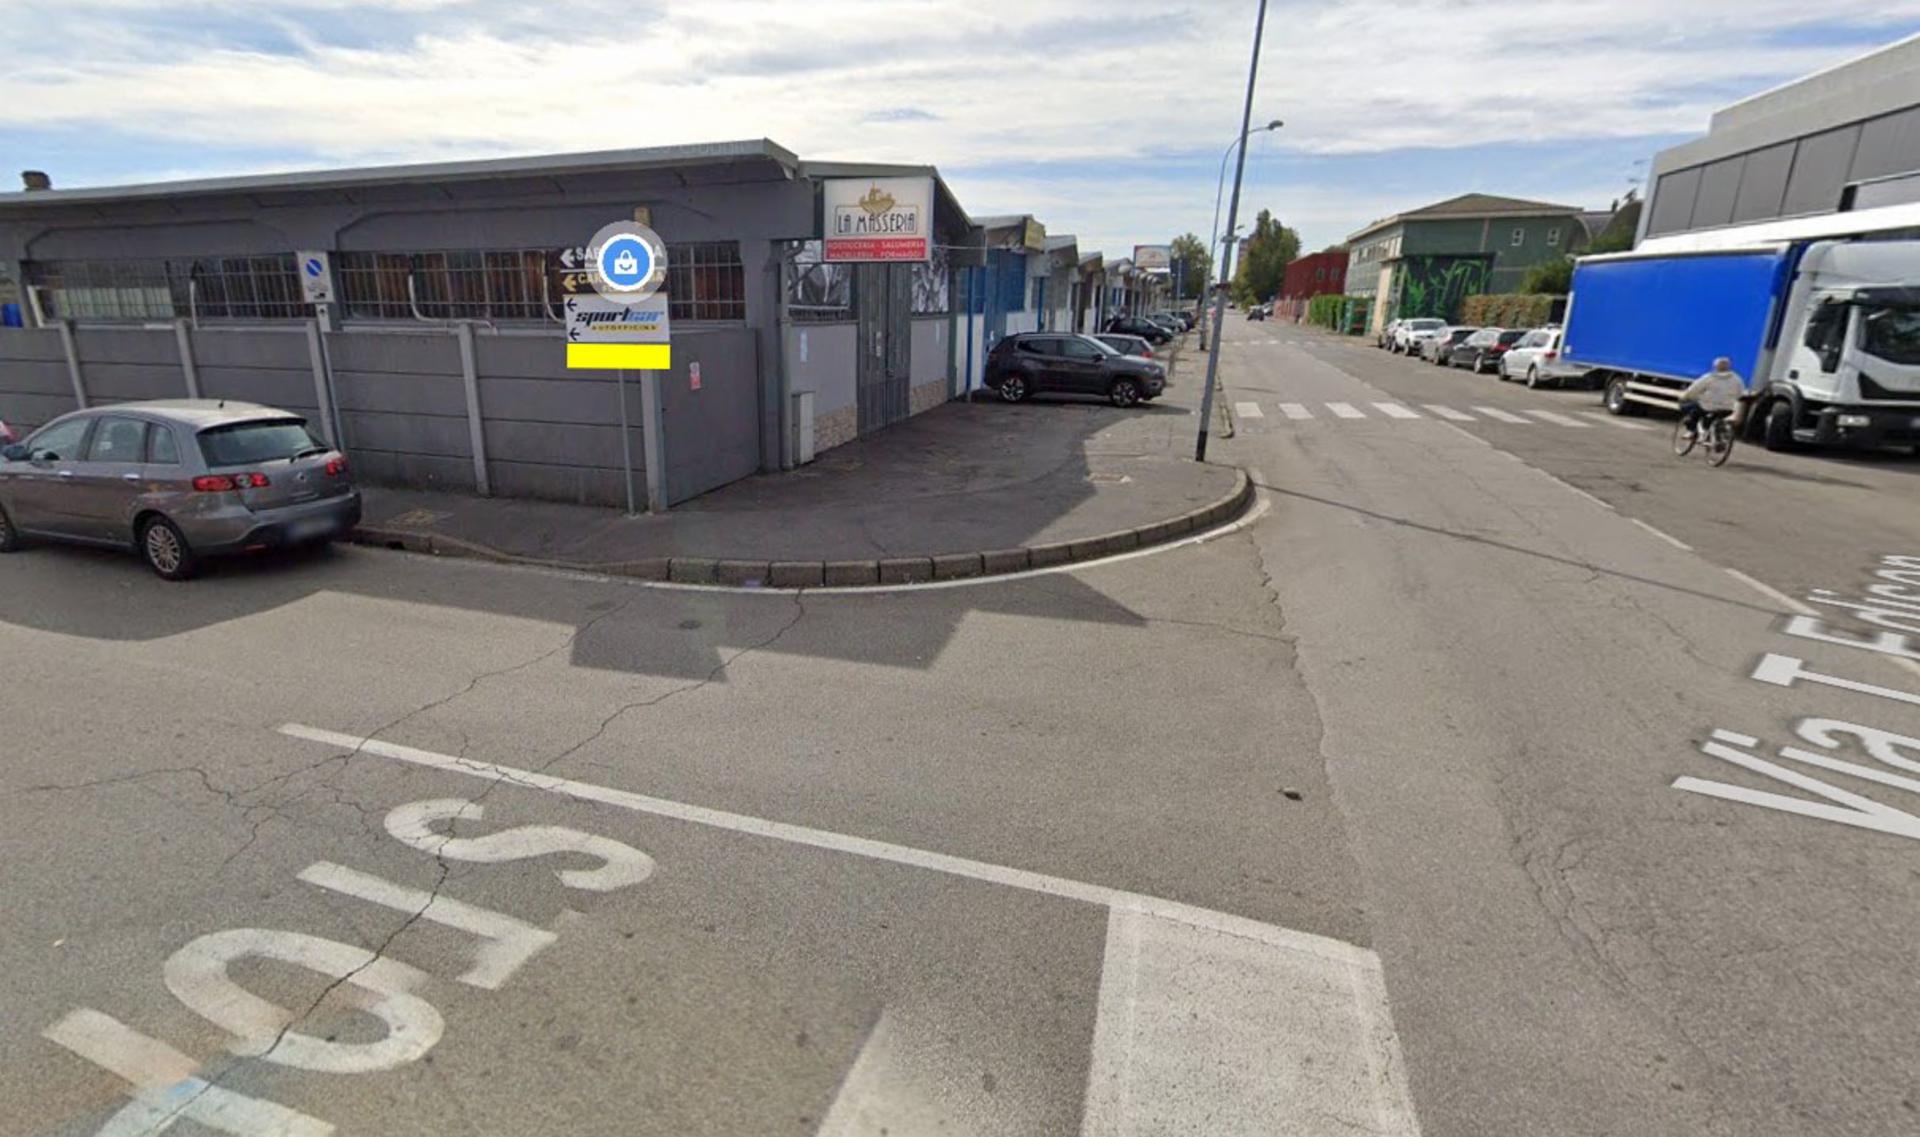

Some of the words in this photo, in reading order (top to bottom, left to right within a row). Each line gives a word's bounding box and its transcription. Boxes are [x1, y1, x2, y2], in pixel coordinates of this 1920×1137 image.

[838, 214, 851, 233] LA
[856, 213, 915, 232] MASSERIA
[1670, 717, 1920, 840] Via
